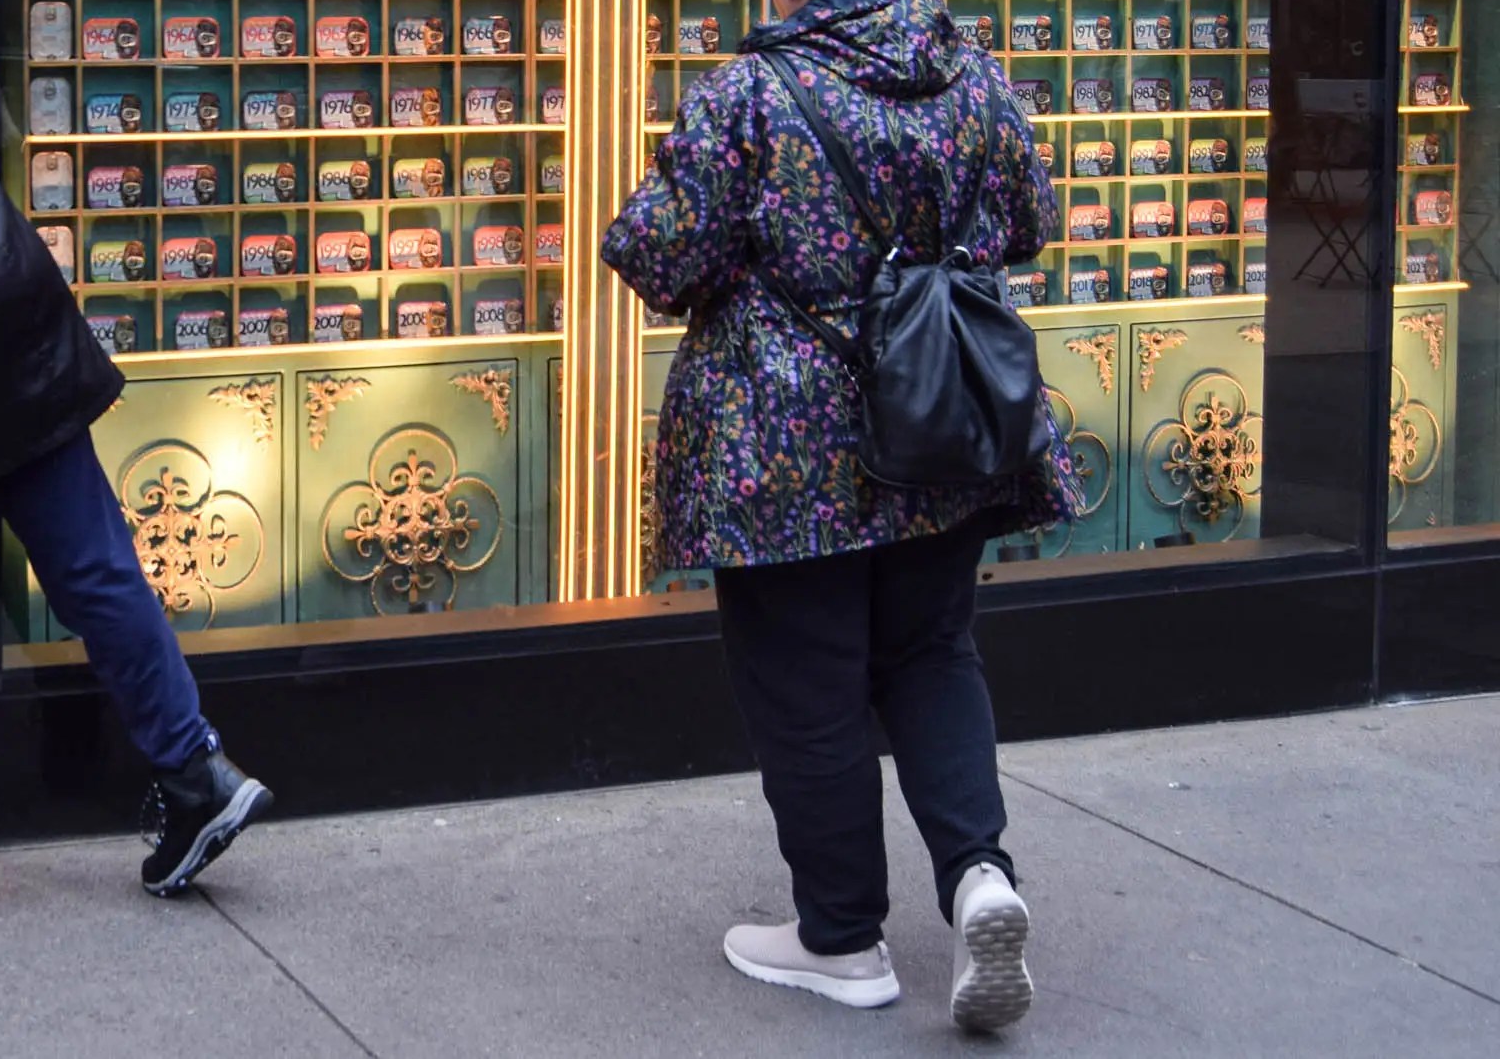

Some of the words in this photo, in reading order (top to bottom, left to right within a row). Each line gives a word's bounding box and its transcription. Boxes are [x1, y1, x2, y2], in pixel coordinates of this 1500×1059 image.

[86, 28, 116, 43] 1964
[166, 28, 196, 42] 1964
[245, 27, 274, 41] 1965
[318, 27, 347, 42] 1965
[398, 25, 423, 41] 1966
[466, 25, 493, 40] 1966
[680, 25, 701, 39] 968
[958, 25, 977, 37] 970
[1013, 25, 1036, 38] 1970
[1076, 26, 1096, 37] 1971
[1136, 26, 1156, 37] 1971
[1018, 88, 1035, 101] 981
[1077, 89, 1096, 101] 1981
[1134, 86, 1157, 99] 1982
[1190, 85, 1210, 98] 982
[1248, 85, 1268, 97] 1983
[169, 102, 197, 117] 1975
[247, 101, 275, 116] 1975
[324, 100, 351, 114] 1976
[394, 97, 421, 113] 1976
[468, 96, 496, 111] 1977
[546, 94, 564, 110] 197
[90, 104, 119, 119] 1974
[322, 172, 349, 186] 1986
[467, 167, 493, 182] 1987
[544, 165, 563, 180] 198
[92, 178, 122, 192] 1985
[166, 175, 197, 190] 1985
[246, 174, 275, 189] 1986
[478, 236, 504, 251] 1998
[164, 250, 194, 265] 1996
[244, 247, 274, 262] 1996
[320, 245, 347, 259] 1997
[1072, 280, 1094, 292] 2017
[1131, 276, 1153, 288] 2018
[1188, 274, 1212, 286] 2019
[1009, 283, 1030, 295] 2016
[316, 314, 342, 330] 2007
[400, 311, 427, 326] 2008
[476, 307, 504, 323] 2008
[92, 325, 115, 340] 006
[178, 321, 208, 337] 2006
[241, 319, 269, 334] 2007
